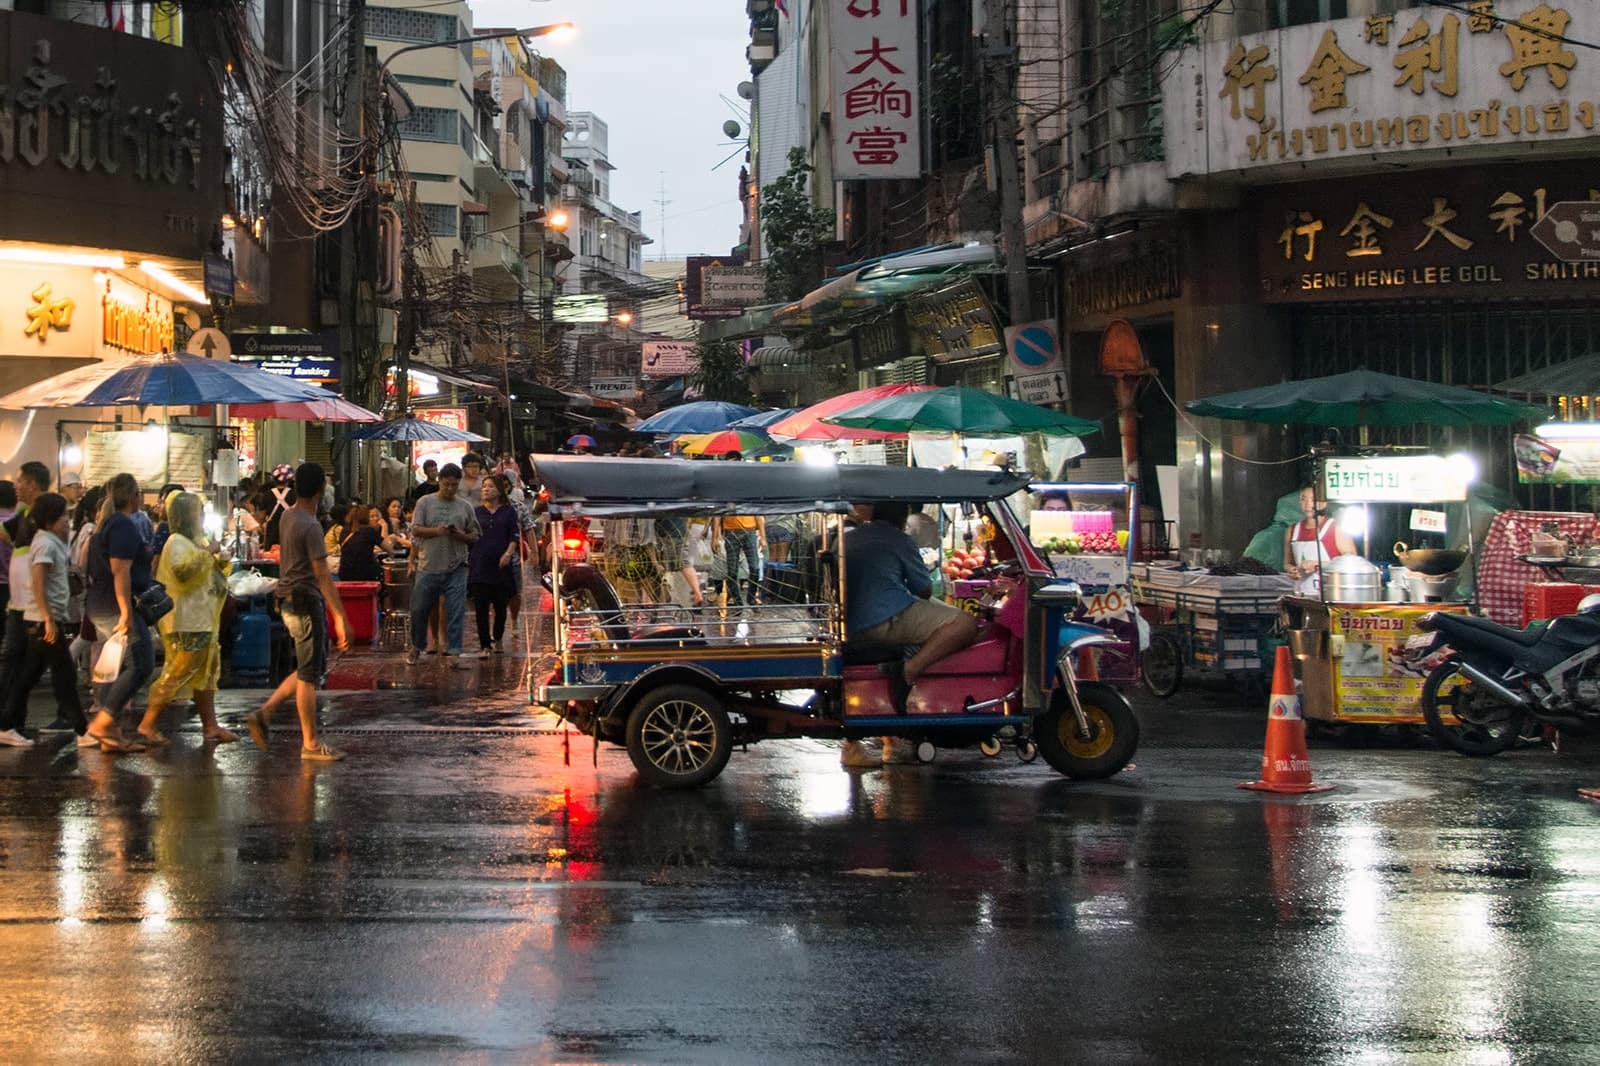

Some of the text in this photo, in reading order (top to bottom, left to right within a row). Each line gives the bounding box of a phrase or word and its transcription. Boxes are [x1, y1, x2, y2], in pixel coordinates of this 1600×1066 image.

[1302, 272, 1347, 289] SENG
[1355, 270, 1405, 286] HENG
[1413, 267, 1450, 284] LEE
[1526, 263, 1599, 279] SMITH
[24, 283, 75, 341] 和
